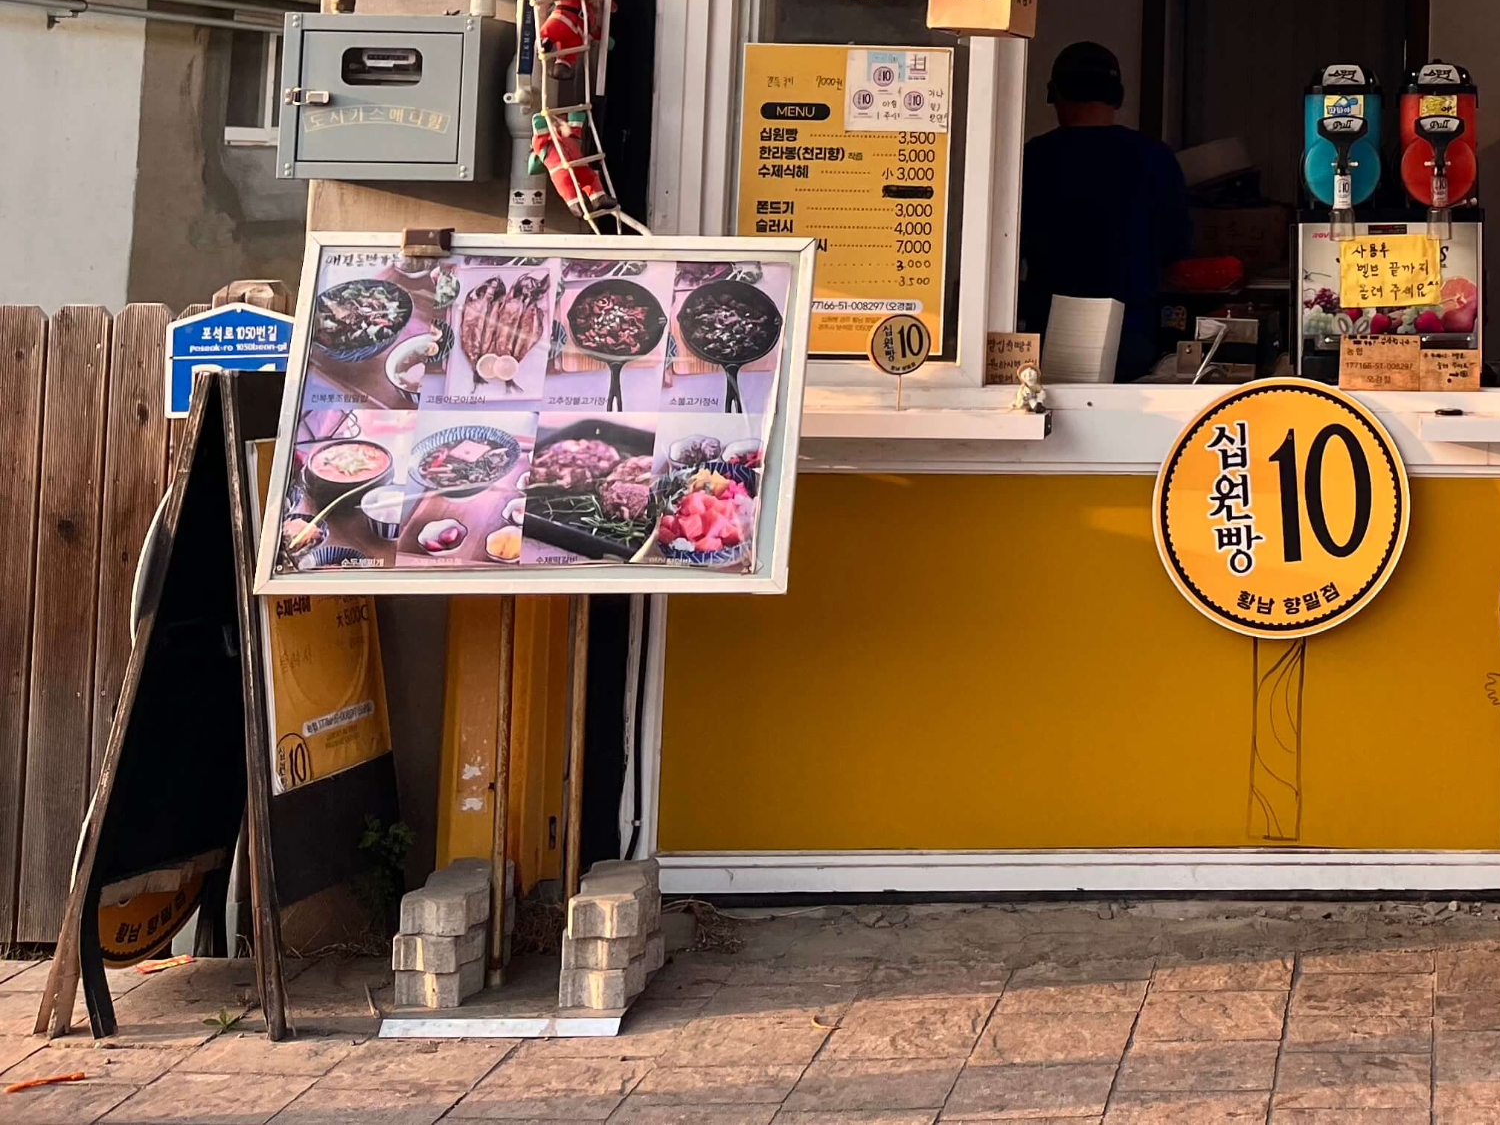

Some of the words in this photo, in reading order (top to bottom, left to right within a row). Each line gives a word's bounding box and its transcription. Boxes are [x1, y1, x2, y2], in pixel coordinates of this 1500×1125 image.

[776, 106, 816, 118] MENU
[759, 128, 799, 142] 십원빵
[897, 132, 936, 145] 3,500
[758, 146, 845, 162] 한라봉(천리향)
[898, 149, 935, 164] 5,000
[882, 168, 894, 180] 小
[896, 167, 935, 181] 3,000
[756, 201, 795, 215] 쫀드기
[894, 203, 933, 218] 3,000
[755, 219, 794, 234] 슬러시
[893, 222, 932, 236] 4,000
[895, 239, 932, 255] 7,000
[201, 326, 235, 342] 포석로
[235, 324, 278, 342] 1050번길
[897, 323, 923, 359] 10
[547, 395, 609, 407] 고추장불고기정
[1206, 422, 1265, 575] 십원빵
[1268, 423, 1373, 563] 10
[1236, 589, 1275, 615] 황남
[1283, 581, 1342, 615] 향밀점
[289, 742, 307, 787] 10
